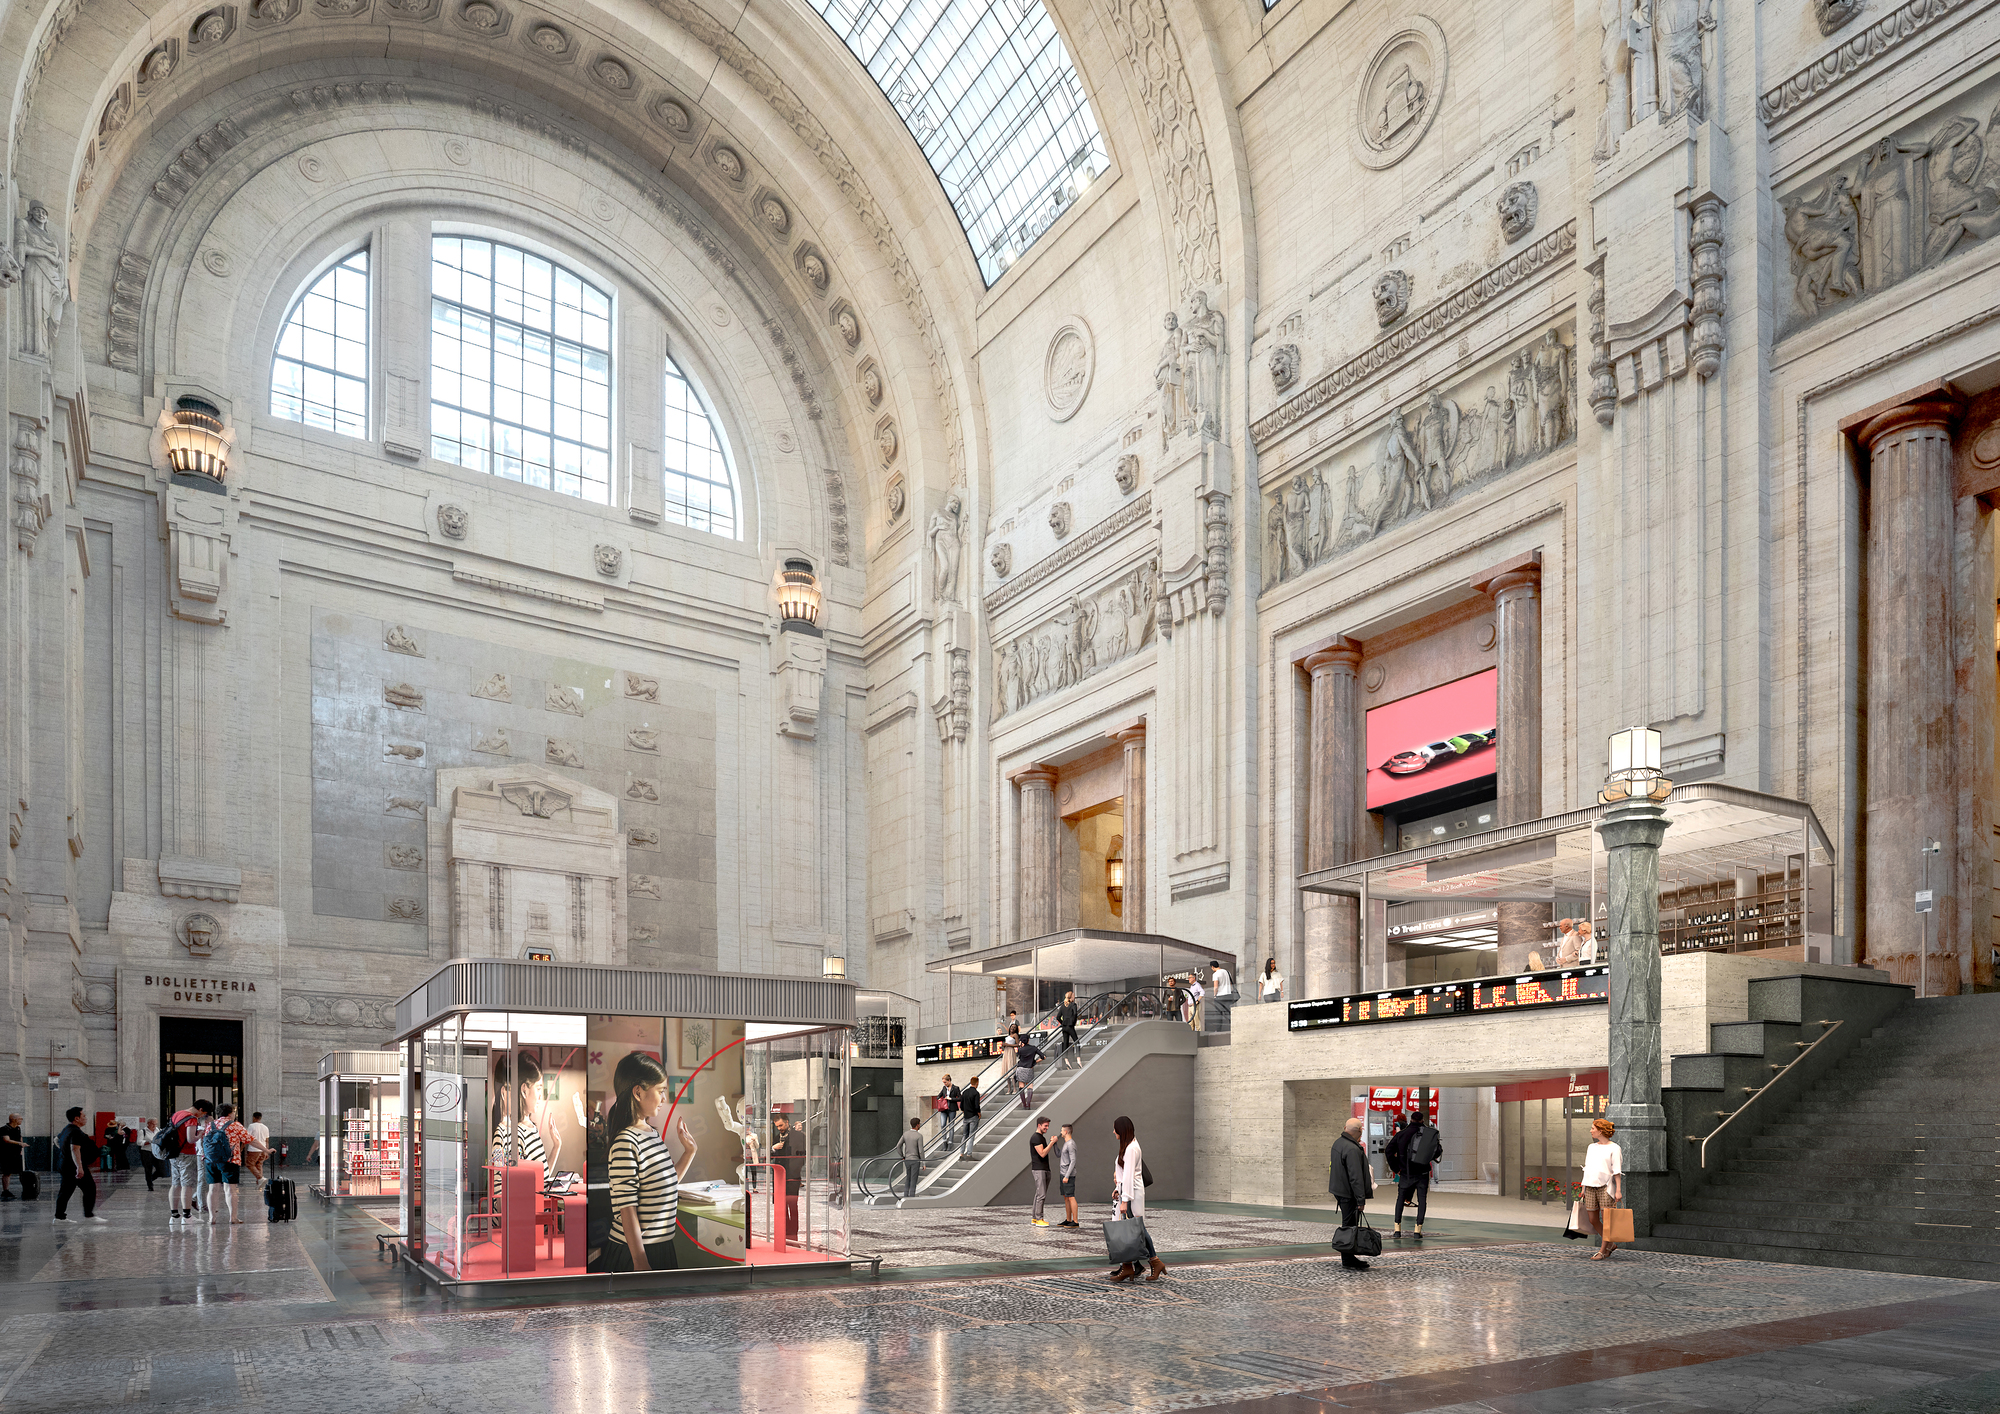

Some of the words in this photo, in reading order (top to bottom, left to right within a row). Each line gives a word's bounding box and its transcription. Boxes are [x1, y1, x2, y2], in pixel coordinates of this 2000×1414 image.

[1423, 920, 1442, 930] Trains
[144, 975, 256, 992] BIGLIETTERIA
[174, 991, 223, 1004] OVEST
